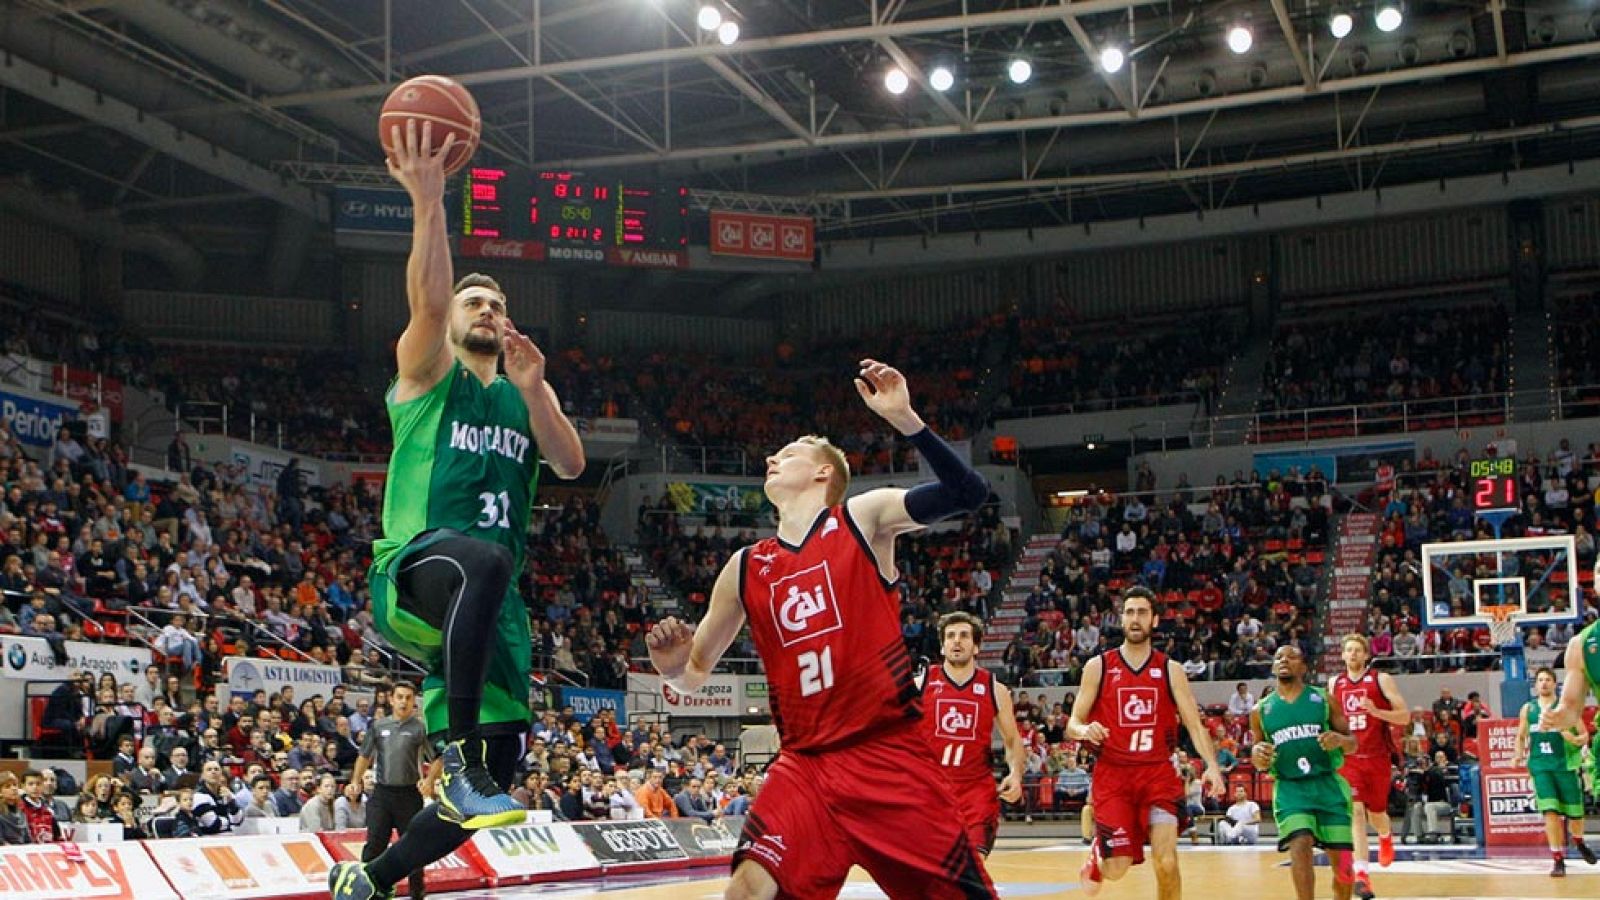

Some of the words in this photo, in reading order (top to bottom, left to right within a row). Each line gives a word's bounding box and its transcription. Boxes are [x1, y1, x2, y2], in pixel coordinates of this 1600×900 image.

[548, 247, 604, 261] MONDO
[633, 252, 678, 267] AMBAR
[1470, 458, 1513, 478] 05:48
[1475, 479, 1513, 507] 21
[477, 490, 510, 529] 31
[797, 645, 834, 697] 21
[697, 686, 732, 696] agoza
[1348, 714, 1368, 731] 25
[1129, 729, 1154, 752] 15
[941, 743, 964, 767] 11
[1297, 757, 1312, 774] 9
[488, 826, 561, 857] DKV
